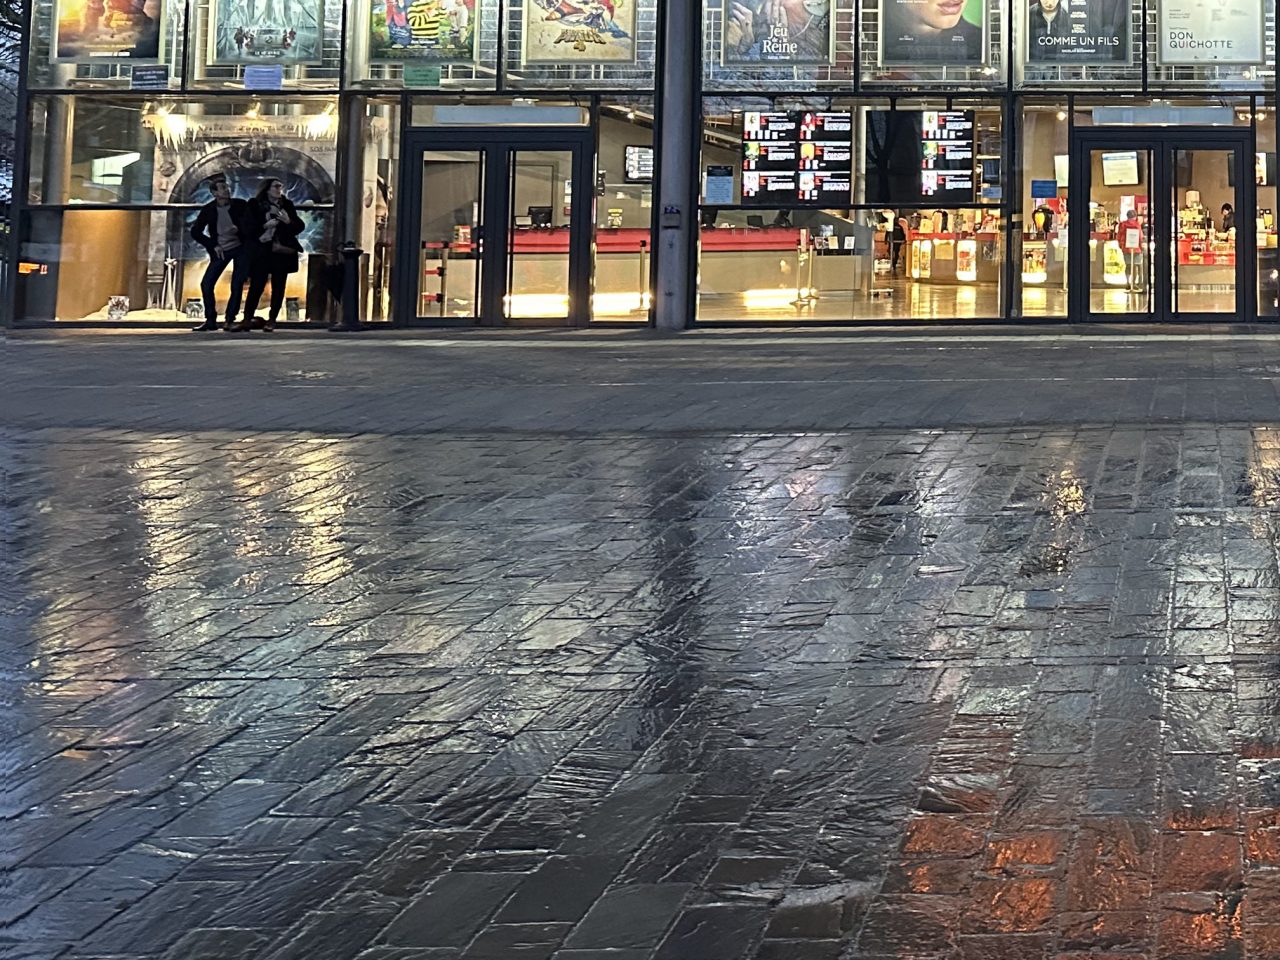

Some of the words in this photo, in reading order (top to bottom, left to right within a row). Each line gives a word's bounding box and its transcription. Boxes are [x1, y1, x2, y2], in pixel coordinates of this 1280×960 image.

[768, 24, 788, 40] Jeu
[1169, 32, 1194, 40] DON
[1038, 36, 1078, 46] COMME
[1080, 36, 1095, 46] UN
[1098, 36, 1120, 46] FILS
[1169, 40, 1234, 49] QUICHOTTE
[762, 40, 798, 53] Reine
